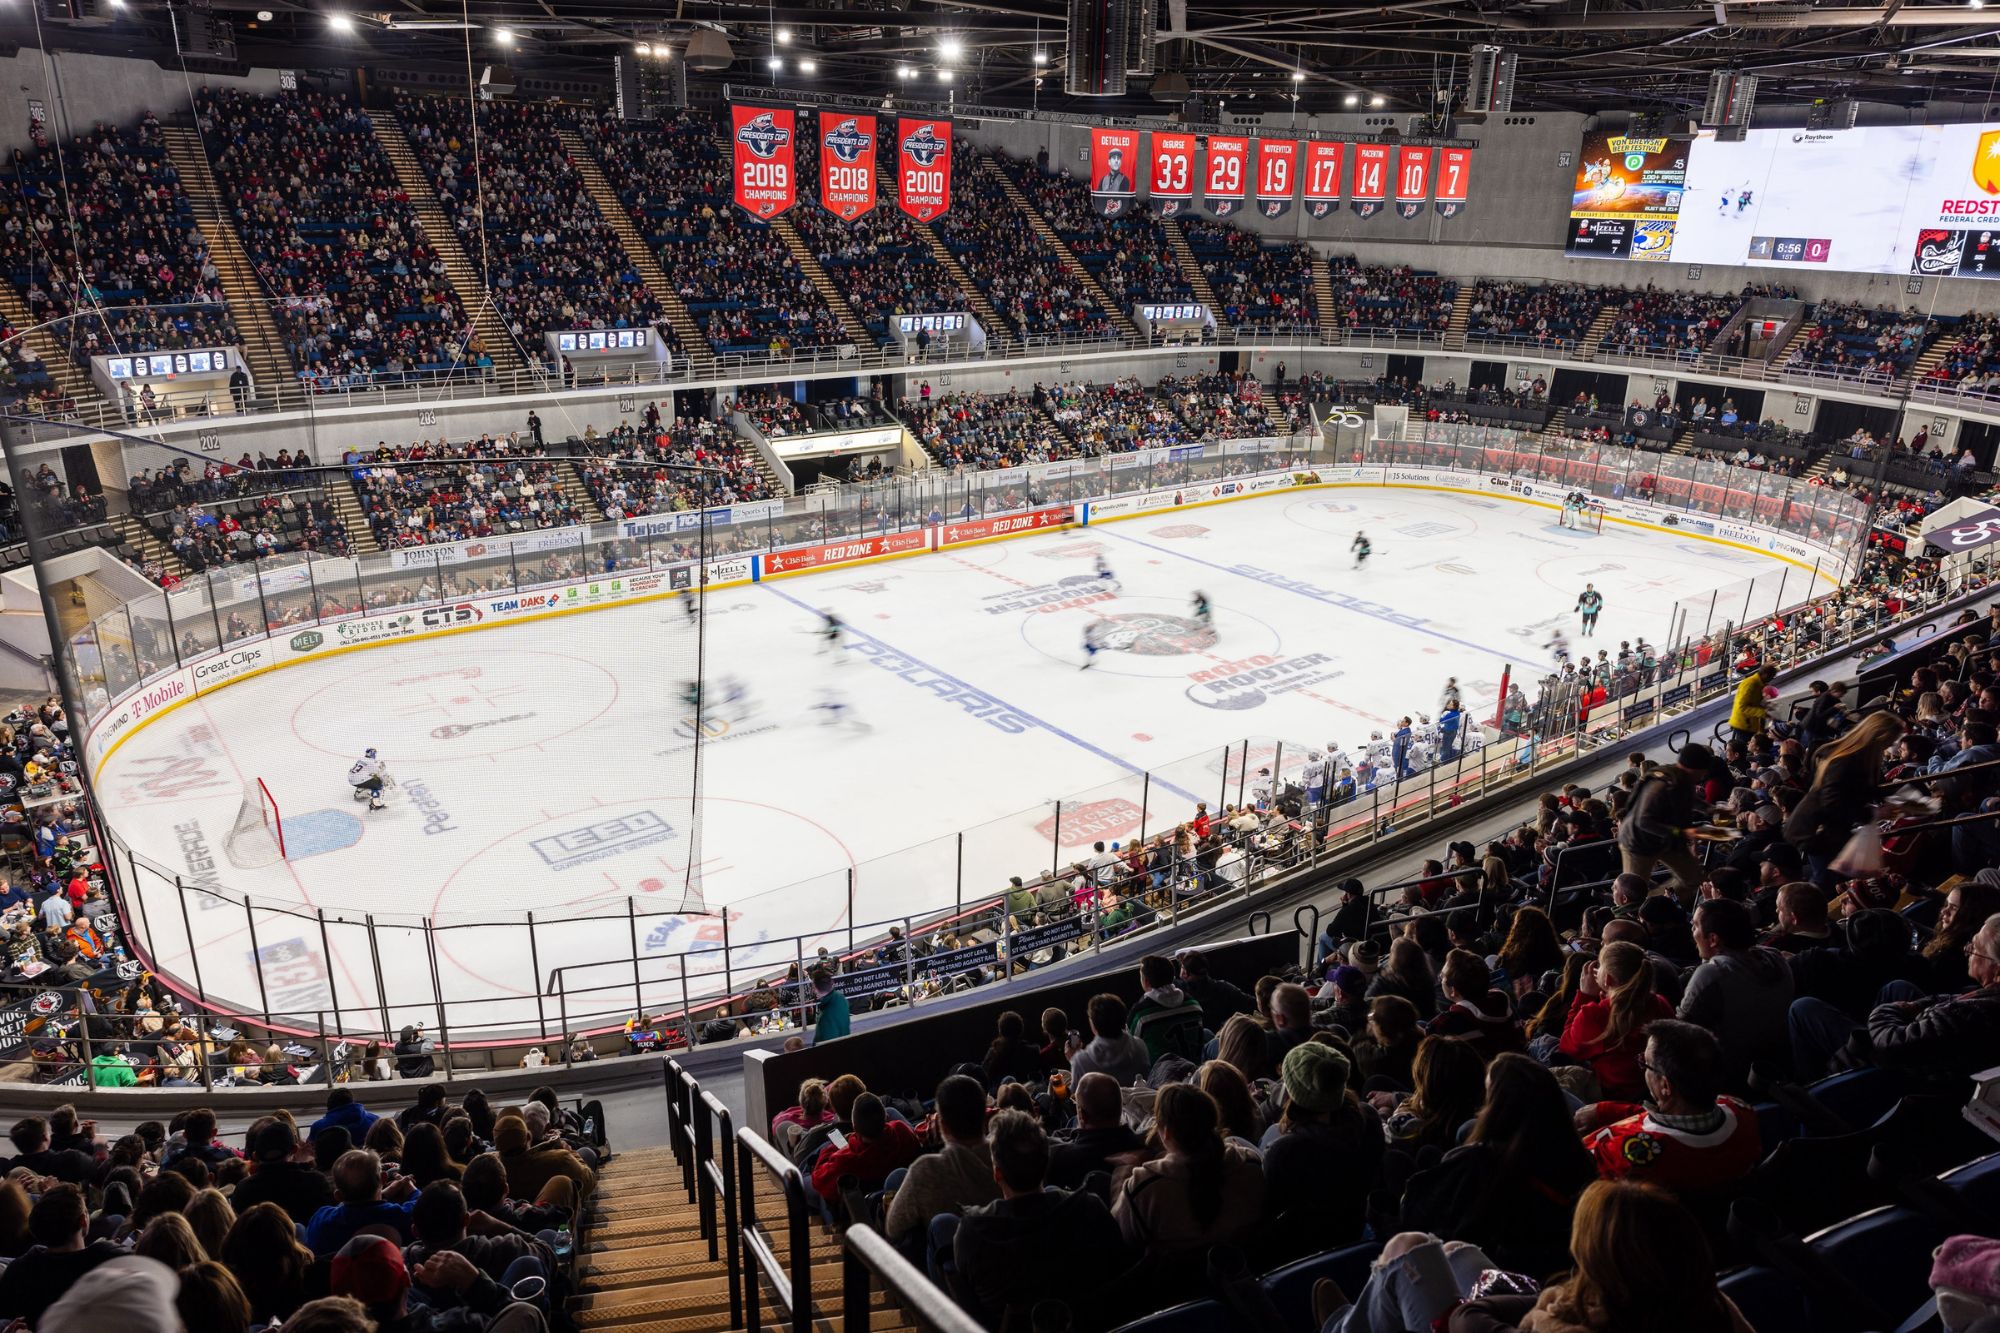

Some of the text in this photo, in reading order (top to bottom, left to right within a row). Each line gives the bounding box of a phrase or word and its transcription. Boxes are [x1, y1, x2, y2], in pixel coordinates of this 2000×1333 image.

[281, 76, 297, 89] 306
[30, 106, 46, 121] 305
[741, 131, 787, 142] PRESIDENTS CUP
[827, 136, 869, 146] PRESIDENTS CUP
[905, 141, 945, 151] PRESIDENTS CUP
[1212, 141, 1242, 152] CARMICHAEL
[1317, 147, 1335, 156] GEORGE
[1079, 151, 1089, 160] 311
[1558, 156, 1570, 167] 314
[743, 162, 788, 187] 2019
[1157, 153, 1188, 189] 33
[1211, 156, 1240, 190] 29
[1264, 158, 1287, 192] 19
[1312, 160, 1335, 193] 17
[1359, 162, 1380, 193] 14
[829, 166, 868, 190] 2018
[906, 171, 943, 193] 2010
[1403, 165, 1423, 194] 10
[1448, 166, 1460, 194] 7
[744, 189, 787, 200] CHAMPIONS
[829, 193, 868, 203] CHAMPIONS
[906, 194, 943, 205] CHAMPIONS
[1760, 241, 1767, 254] 1
[1777, 243, 1801, 253] 8:56
[1811, 243, 1821, 256] 0
[1975, 263, 1983, 271] 3
[1689, 270, 1701, 279] 315
[1907, 283, 1920, 293] 316
[1362, 358, 1372, 367] 210
[940, 374, 951, 385] 207
[1517, 369, 1526, 379] 211
[620, 402, 635, 412] 204
[1797, 401, 1808, 412] 213
[419, 412, 436, 425] 203
[1932, 424, 1945, 435] 214
[200, 435, 219, 450] 202
[1401, 473, 1430, 482] Solutions
[1491, 478, 1509, 487] Clue
[741, 507, 766, 517] Sports
[623, 519, 673, 536] Turner
[992, 516, 1034, 533] RED ZONE
[1681, 517, 1714, 529] POLARIS
[906, 537, 919, 545] Bank
[1719, 528, 1760, 544] FREEDOM
[538, 537, 581, 549] FREEDOM
[402, 547, 456, 566] JOHNSON
[801, 554, 815, 562] Bank
[824, 542, 872, 561] RED ZONE
[491, 599, 519, 613] TEAM
[520, 595, 546, 608] DAKS
[422, 603, 472, 625] CTS
[349, 624, 384, 635] RIDGE
[424, 619, 473, 631] EXCAVATIONS
[293, 632, 320, 647] MELT
[195, 650, 263, 679] Great Clips
[1203, 653, 1334, 694] ROOTER
[842, 641, 1036, 735] POLARIS
[143, 680, 186, 714] Mobile
[720, 723, 779, 742] DYNAMIX
[1057, 809, 1143, 845] DINER
[645, 917, 686, 951] TEAM
[1050, 927, 1061, 936] NOT
[1035, 939, 1051, 948] STAND
[1051, 933, 1070, 943] AGAINST
[1070, 929, 1081, 937] RAIL
[945, 962, 963, 970] STAND
[962, 957, 985, 967] AGAINST
[985, 954, 996, 962] RAIL
[845, 977, 899, 993] STAND AGAINST RAIL
[16, 1018, 28, 1032] IT
